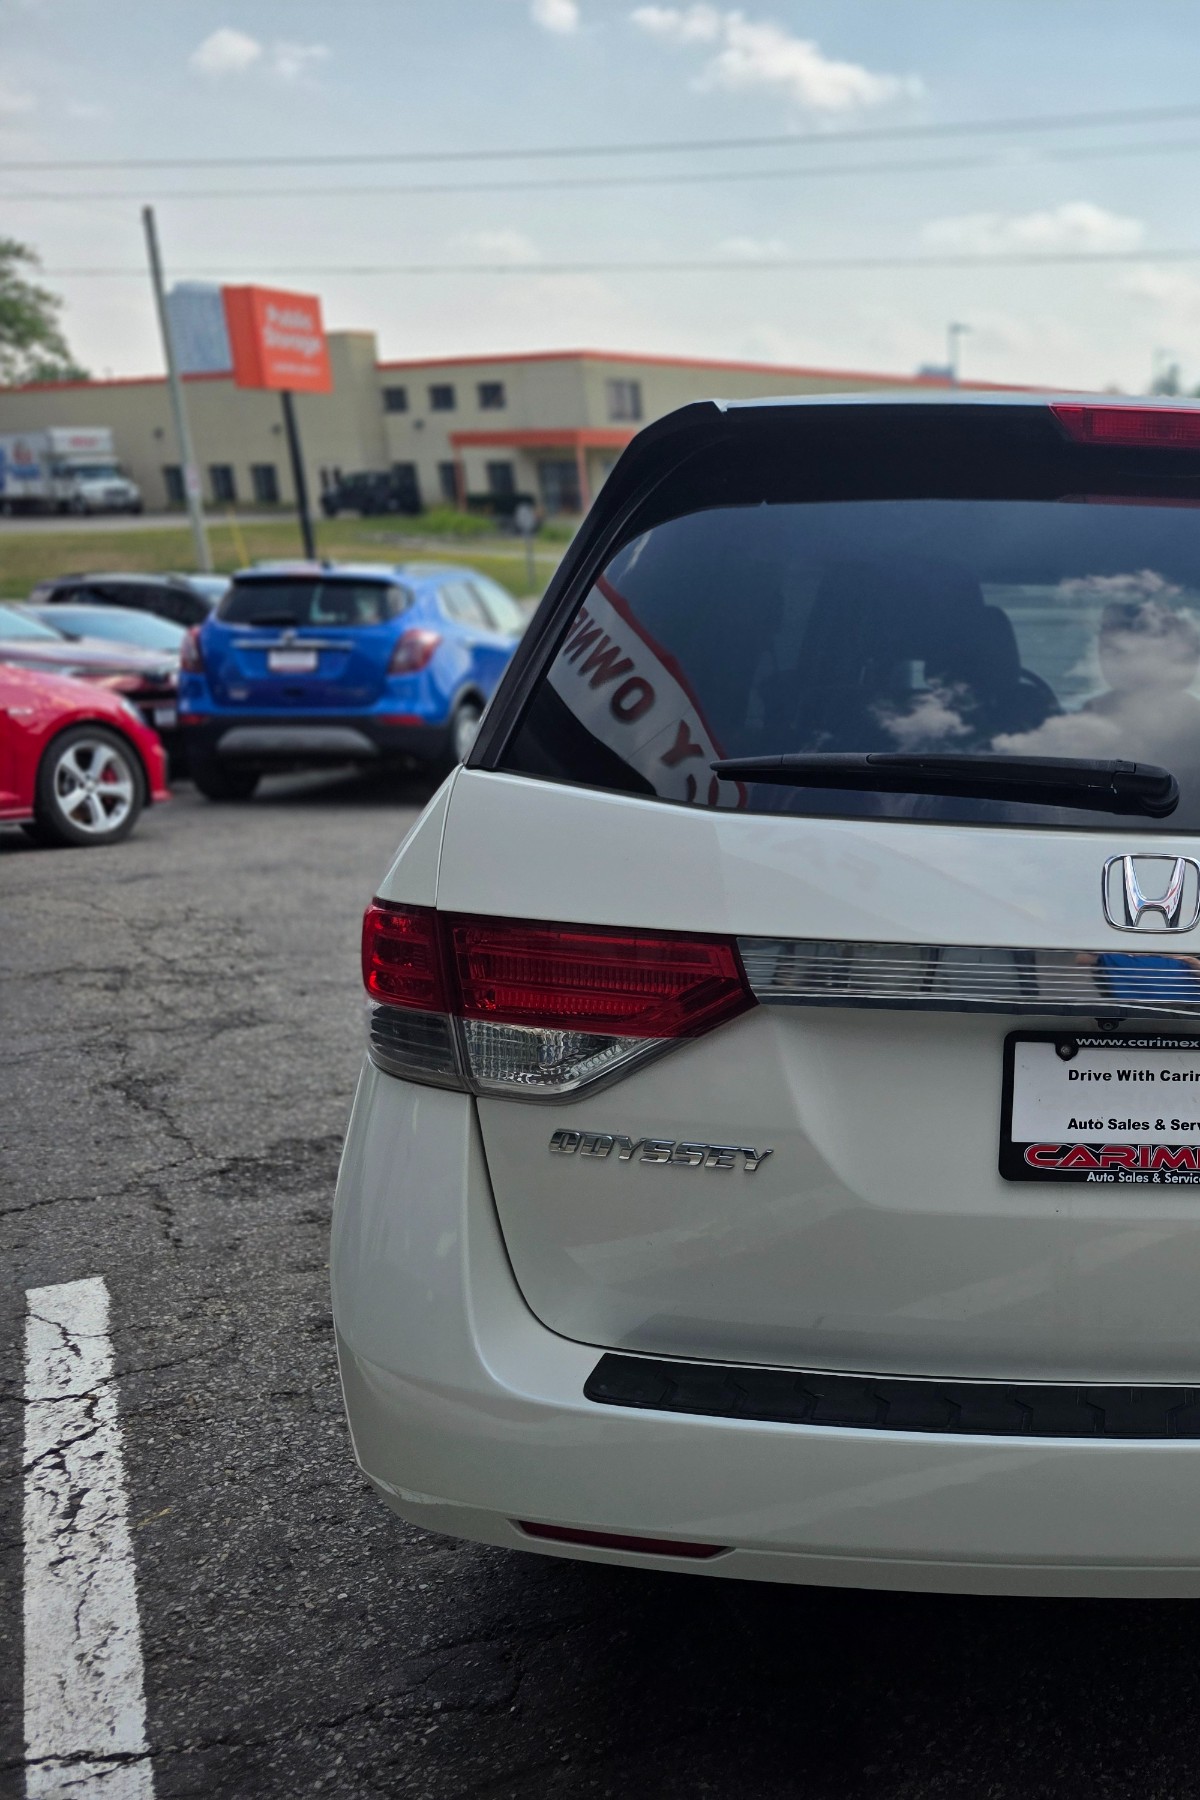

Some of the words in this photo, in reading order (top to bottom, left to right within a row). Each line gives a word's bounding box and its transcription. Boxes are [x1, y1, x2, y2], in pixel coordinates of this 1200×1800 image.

[1068, 1069, 1112, 1082] Drive
[1116, 1069, 1155, 1082] With
[1067, 1118, 1103, 1130] Auto
[1108, 1118, 1150, 1131] Sales
[1154, 1119, 1166, 1131] &
[548, 1128, 774, 1172] ODYSSEY
[1086, 1172, 1114, 1183] Auto
[1118, 1172, 1149, 1183] Sales
[1153, 1172, 1162, 1183] &
